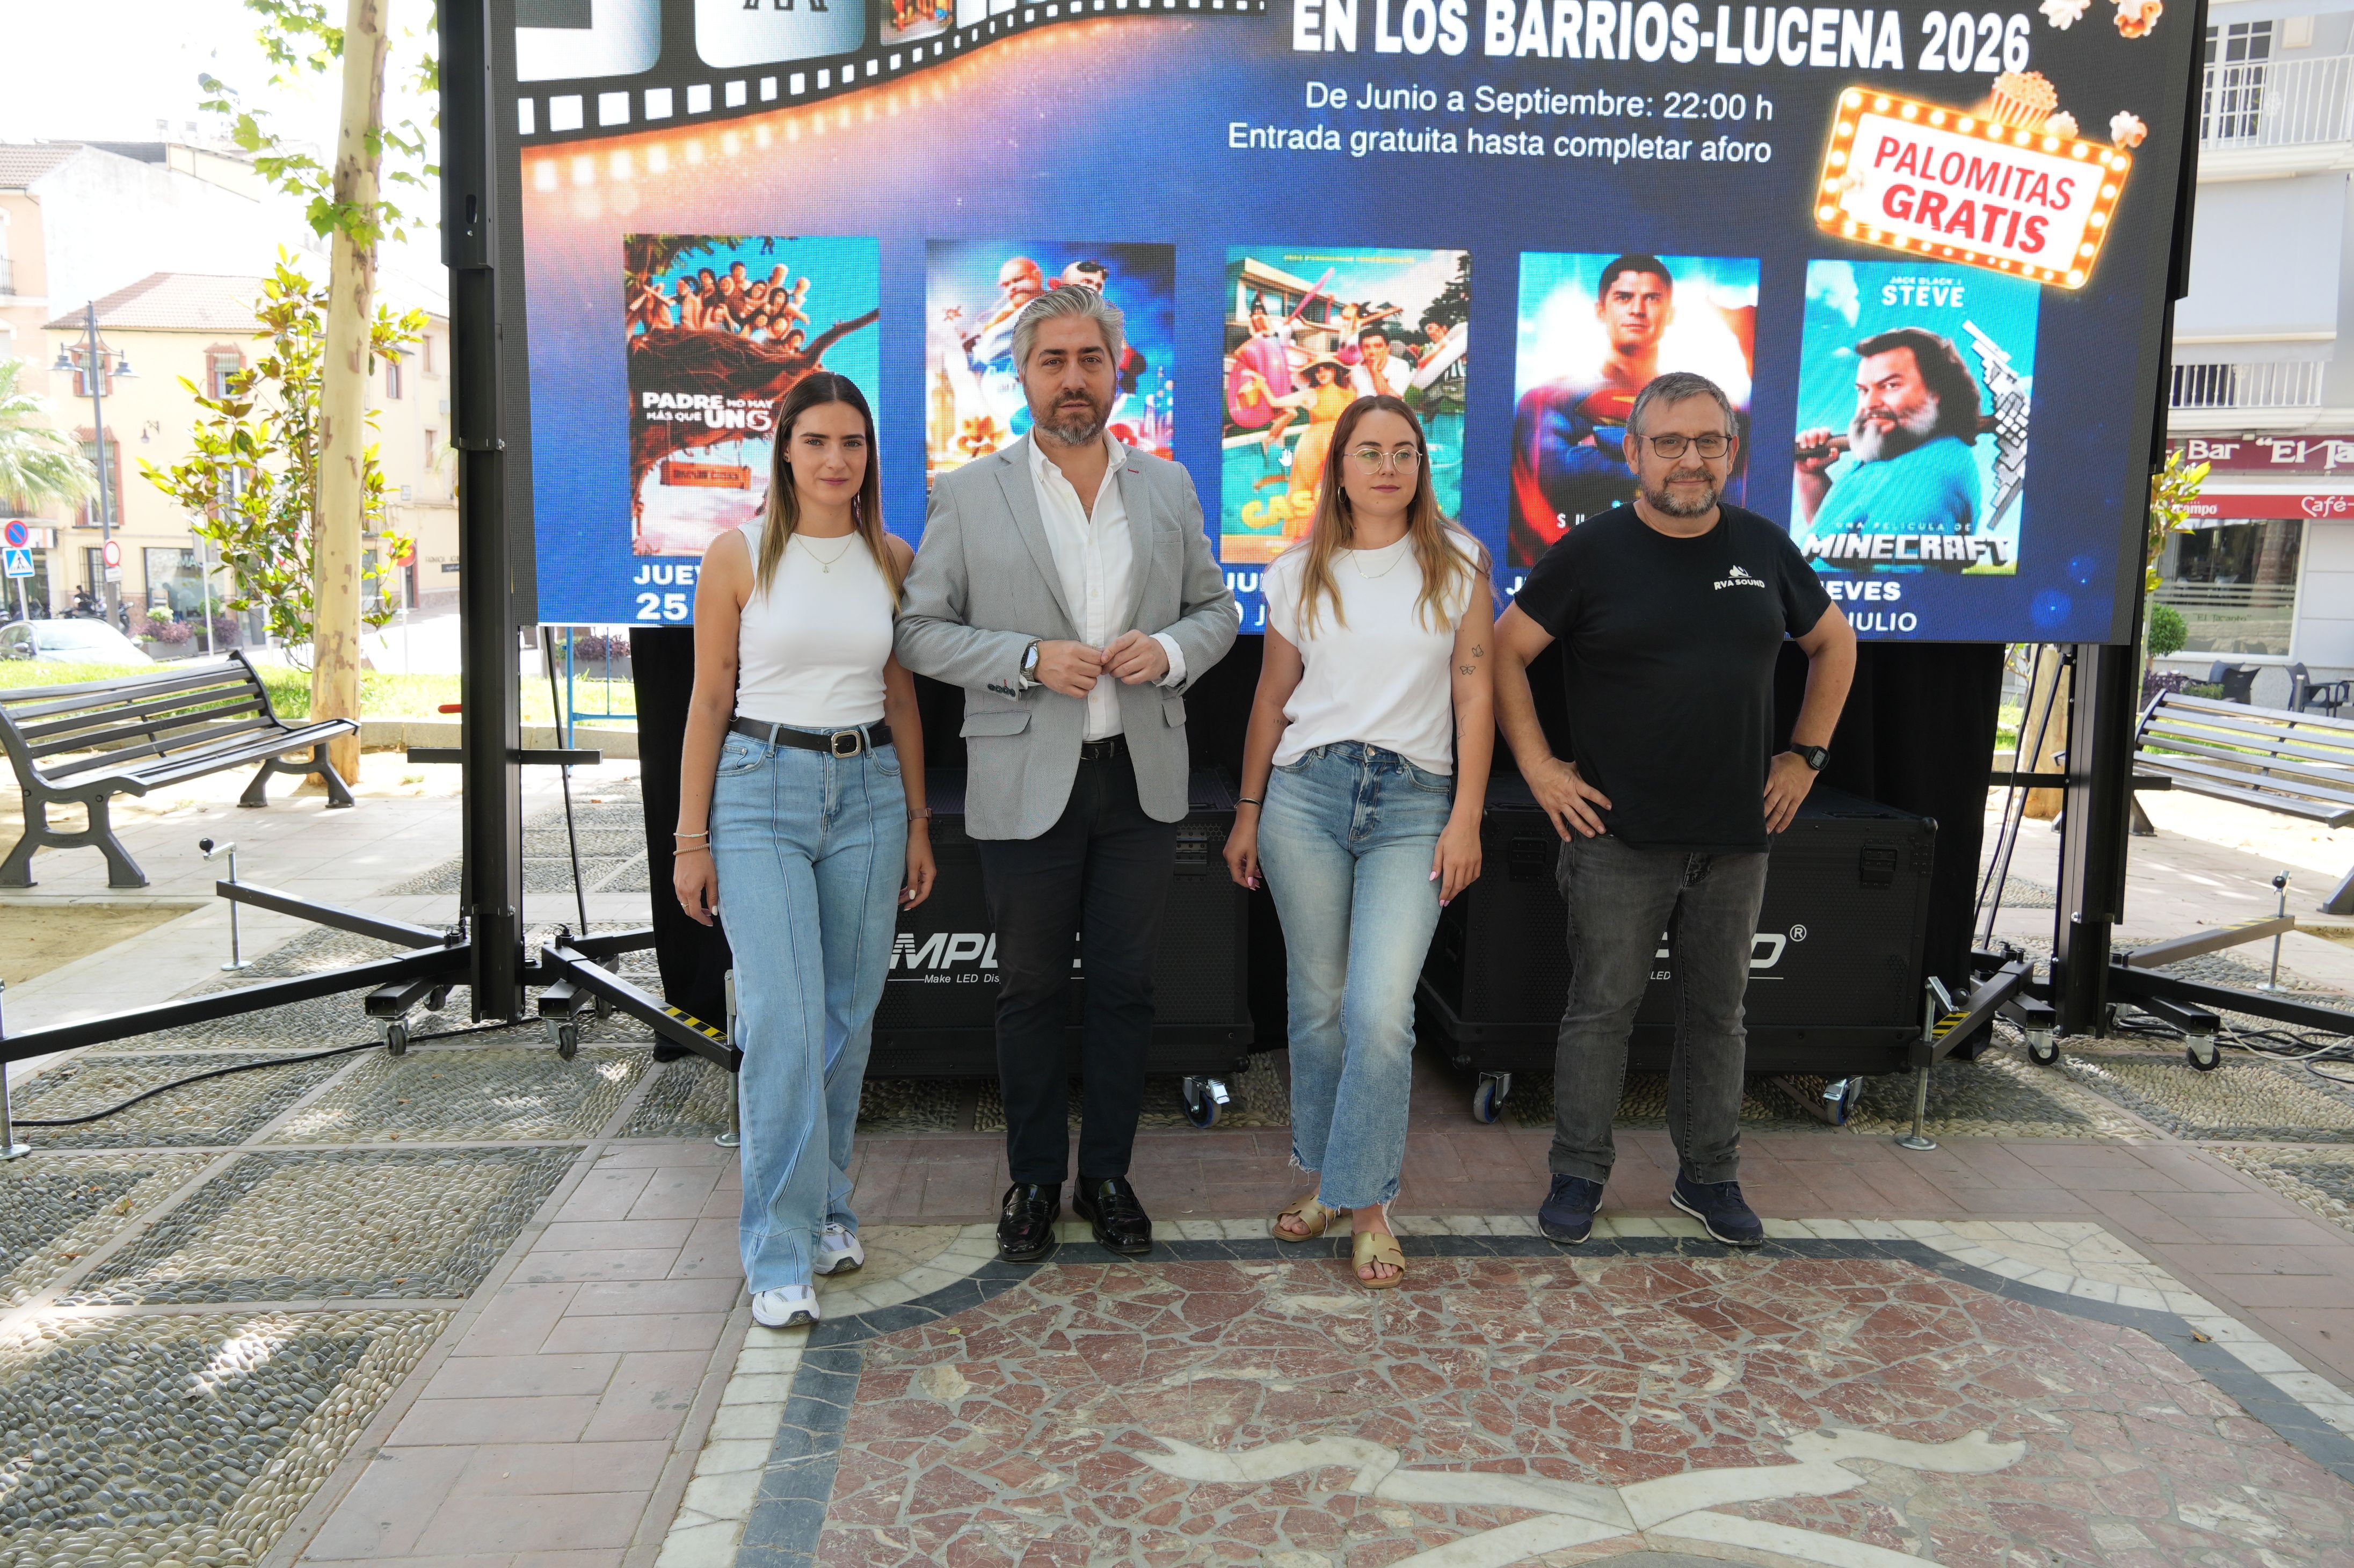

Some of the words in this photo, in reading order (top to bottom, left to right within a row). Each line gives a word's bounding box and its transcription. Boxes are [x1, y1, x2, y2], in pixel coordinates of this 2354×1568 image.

[1293, 0, 1357, 52] EN
[1375, 0, 1469, 55] LOS
[1485, 0, 1905, 70] BARRIOS-LUCENA
[1919, 11, 2032, 73] 2026
[1306, 82, 1347, 109] De
[1356, 84, 1437, 112] Junio
[1447, 92, 1465, 112] a
[1474, 85, 1653, 120] Septiembre:
[1662, 92, 1746, 121] 22:00
[1756, 95, 1774, 121] h
[1229, 122, 1341, 151] Entrada
[1350, 125, 1457, 157] gratuita
[1468, 127, 1545, 156] hasta
[1554, 130, 1692, 164] completar
[1700, 136, 1772, 163] aforo
[1874, 135, 2076, 211] PALOMITAS
[1882, 183, 2050, 253] GRATIS
[1882, 285, 1965, 308] STEVE
[642, 392, 723, 409] PADRE
[674, 411, 702, 422] QUE
[2187, 439, 2240, 460] Bar
[1803, 533, 2009, 561] MINECRAFT
[1713, 580, 1734, 591] RVA
[1735, 579, 1766, 589] SOUND
[1818, 580, 1901, 601] EVES
[636, 592, 688, 621] 25
[924, 974, 951, 984] Make
[956, 974, 978, 983] LED
[984, 974, 1001, 984] Dis
[1650, 971, 1672, 981] LED
